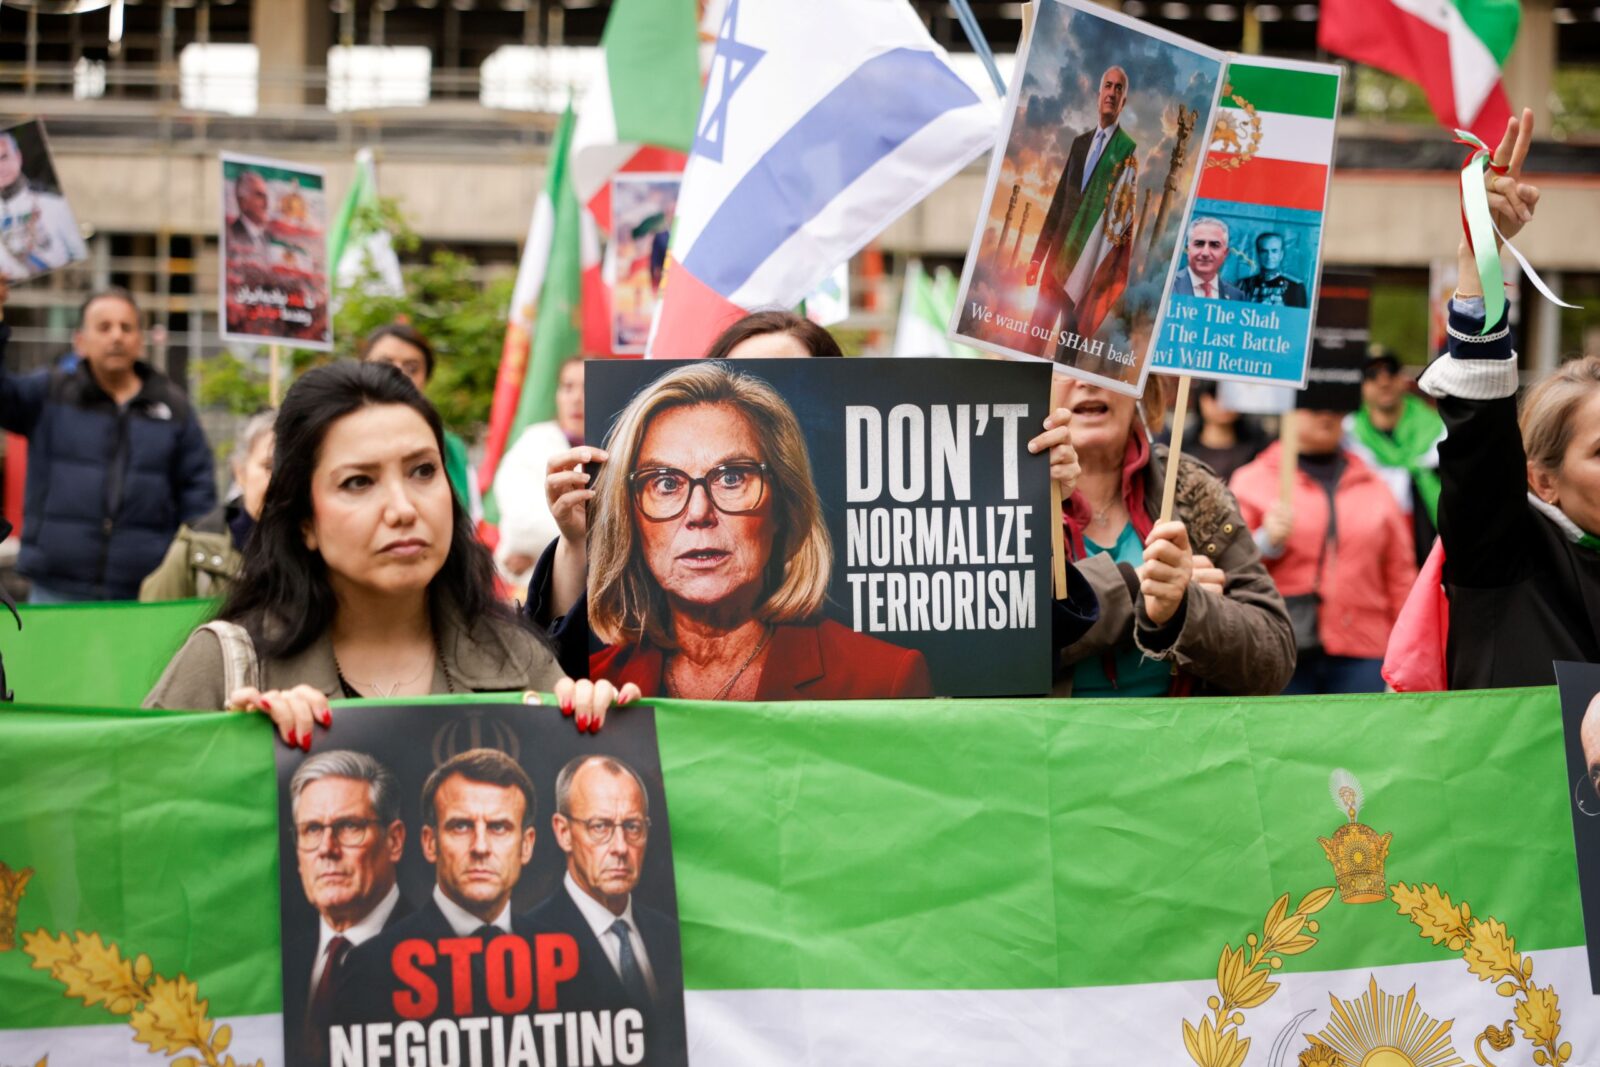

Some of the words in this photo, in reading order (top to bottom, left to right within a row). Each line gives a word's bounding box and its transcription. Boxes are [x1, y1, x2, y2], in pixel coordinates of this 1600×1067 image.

[972, 303, 993, 322] We
[996, 313, 1029, 335] want
[1031, 325, 1054, 342] our
[1058, 331, 1104, 356] SHAH
[1107, 344, 1138, 368] back
[1166, 300, 1198, 320] Live
[1204, 303, 1235, 324] The
[1239, 308, 1280, 330] Shah
[1168, 323, 1198, 344] The
[1203, 327, 1236, 348] Last
[1242, 331, 1291, 354] Battle
[1180, 347, 1213, 370] Will
[1218, 352, 1273, 376] Return
[845, 403, 1029, 503] DON'T
[846, 505, 1034, 568] NORMALIZE
[847, 569, 1036, 633] TERRORISM
[391, 932, 580, 1020] STOP
[329, 1007, 645, 1067] NEGOTIATING
